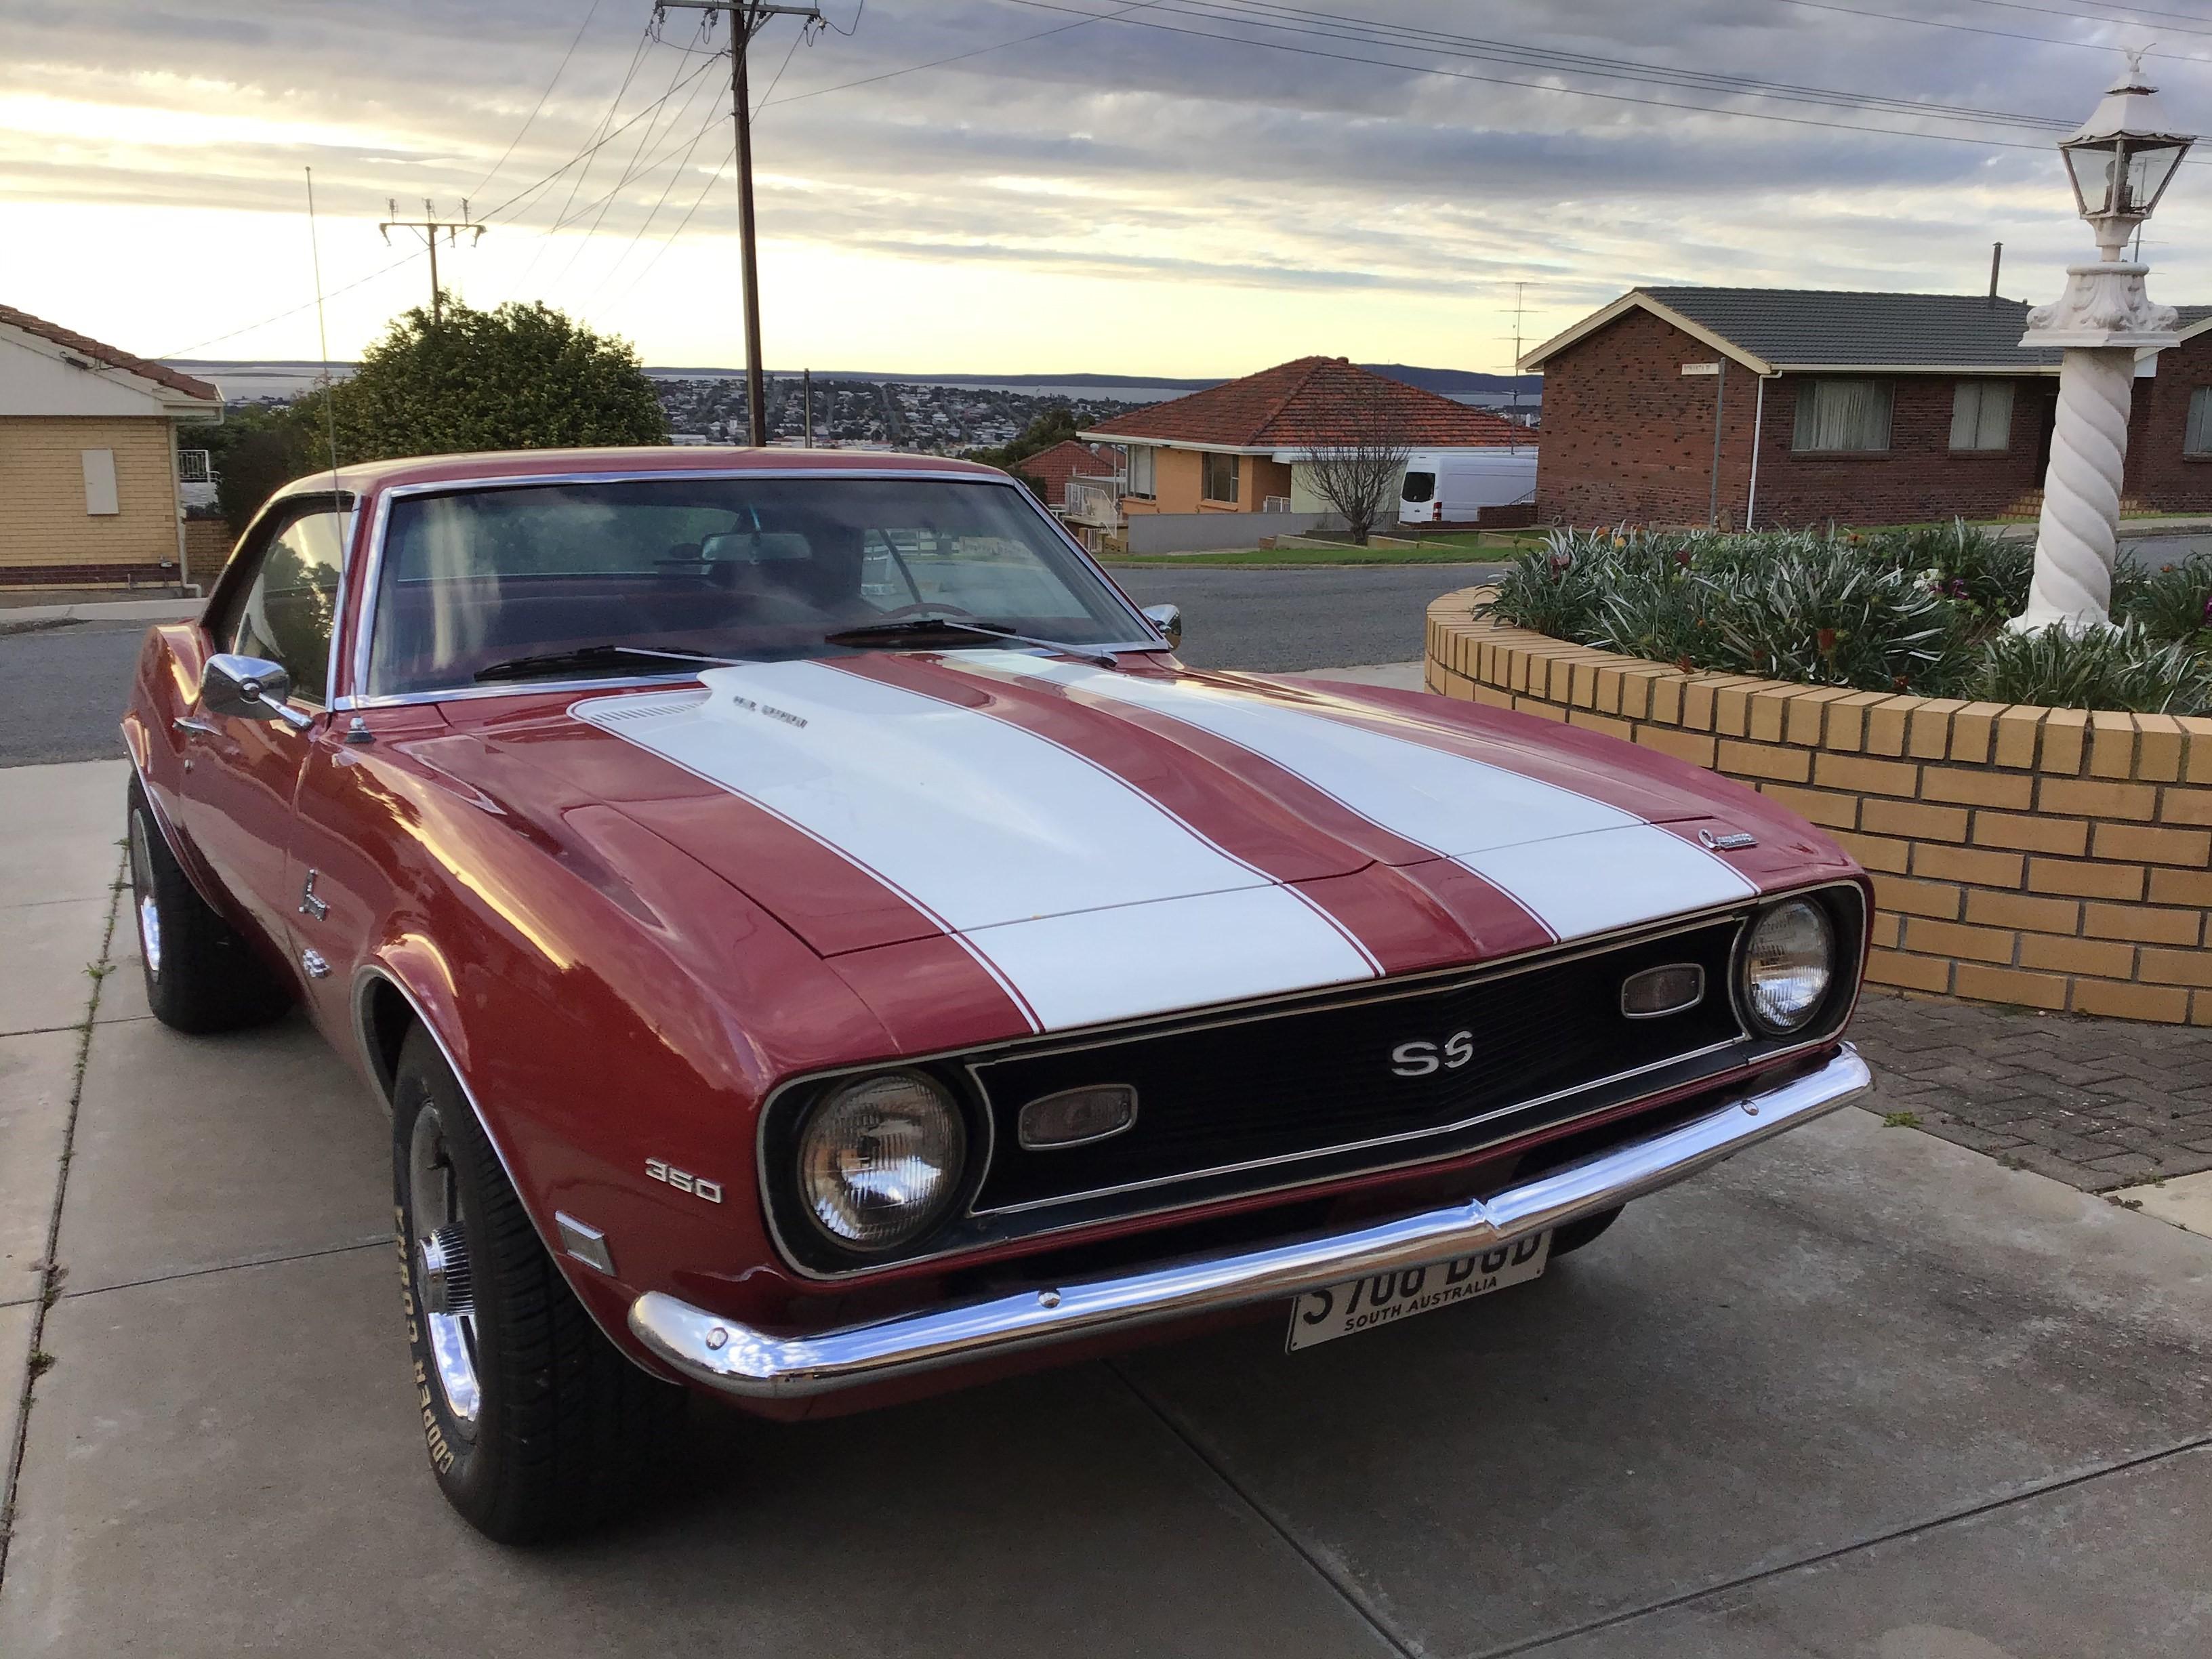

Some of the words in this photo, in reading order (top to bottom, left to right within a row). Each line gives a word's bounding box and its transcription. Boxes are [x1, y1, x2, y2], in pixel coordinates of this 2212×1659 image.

[1391, 1030, 1474, 1077] SS
[644, 1158, 722, 1204] 350
[1344, 1303, 1402, 1332] SOUTH
[1405, 1275, 1497, 1313] AUSTRALIA
[413, 1359, 455, 1475] COOPER
